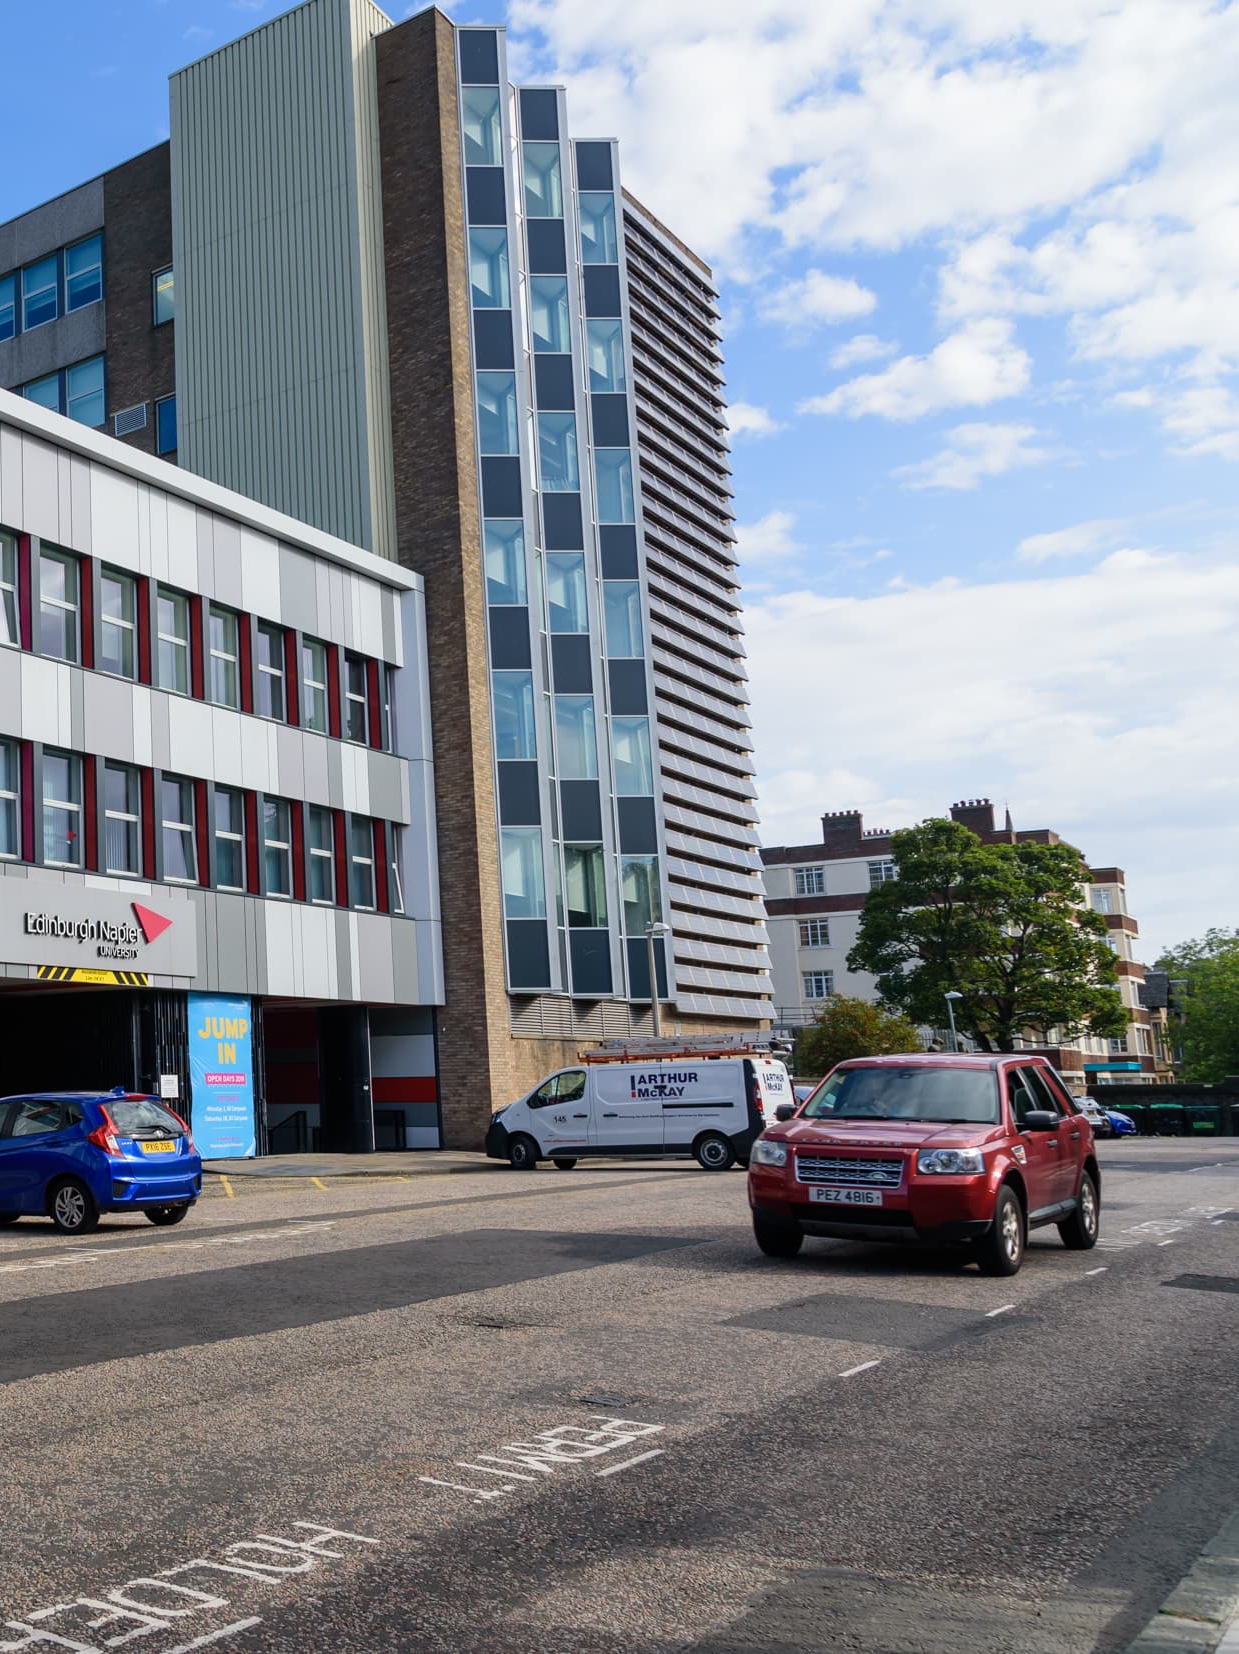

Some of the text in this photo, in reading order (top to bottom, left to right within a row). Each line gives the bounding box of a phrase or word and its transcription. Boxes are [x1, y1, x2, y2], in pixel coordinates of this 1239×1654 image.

[24, 911, 142, 945] Edinburgh Napier
[98, 946, 139, 960] UNIVERSITY
[198, 1016, 248, 1040] JUMP
[217, 1042, 237, 1066] IN
[208, 1075, 221, 1083] OPEN
[223, 1075, 235, 1083] DAYS
[637, 1072, 699, 1085] ARTHUR
[766, 1073, 785, 1083] ARTHUR
[637, 1086, 685, 1098] McKAY
[554, 1115, 567, 1124] 145
[145, 1143, 160, 1153] PX16
[801, 1137, 903, 1147] LAND ROVER
[816, 1188, 874, 1204] PEZ 4816
[418, 1414, 666, 1504] PERMIT
